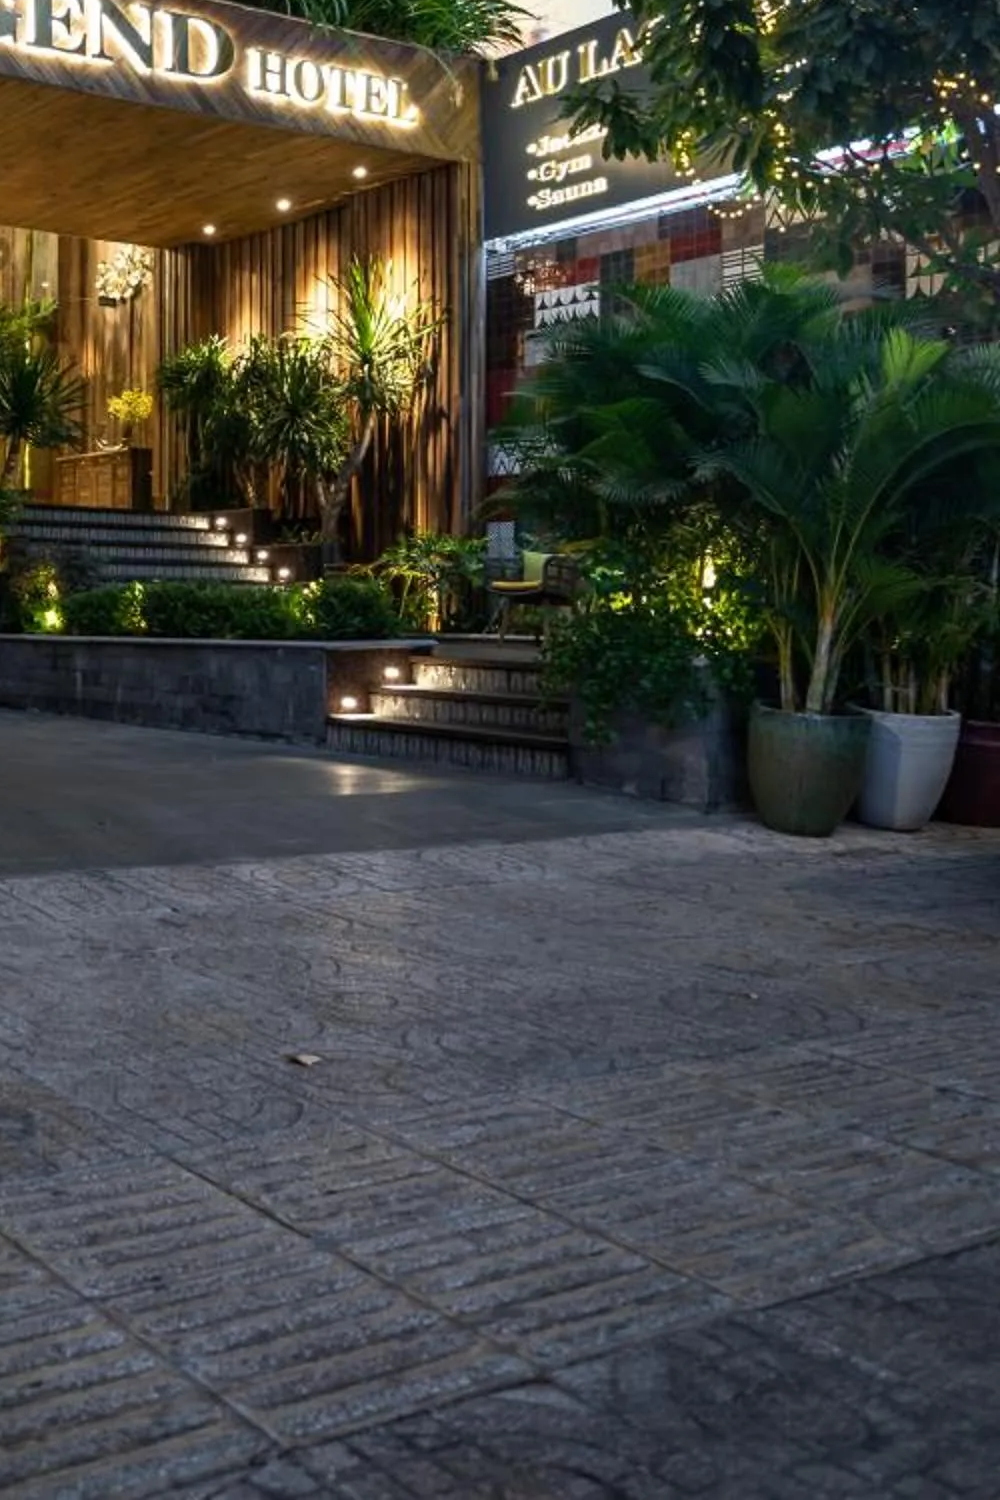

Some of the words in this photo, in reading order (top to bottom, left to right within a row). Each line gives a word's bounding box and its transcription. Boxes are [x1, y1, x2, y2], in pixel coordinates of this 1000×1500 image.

[248, 47, 418, 126] HOTEL
[510, 50, 571, 108] AU
[539, 154, 593, 182] Gym
[535, 177, 608, 211] Sauna
